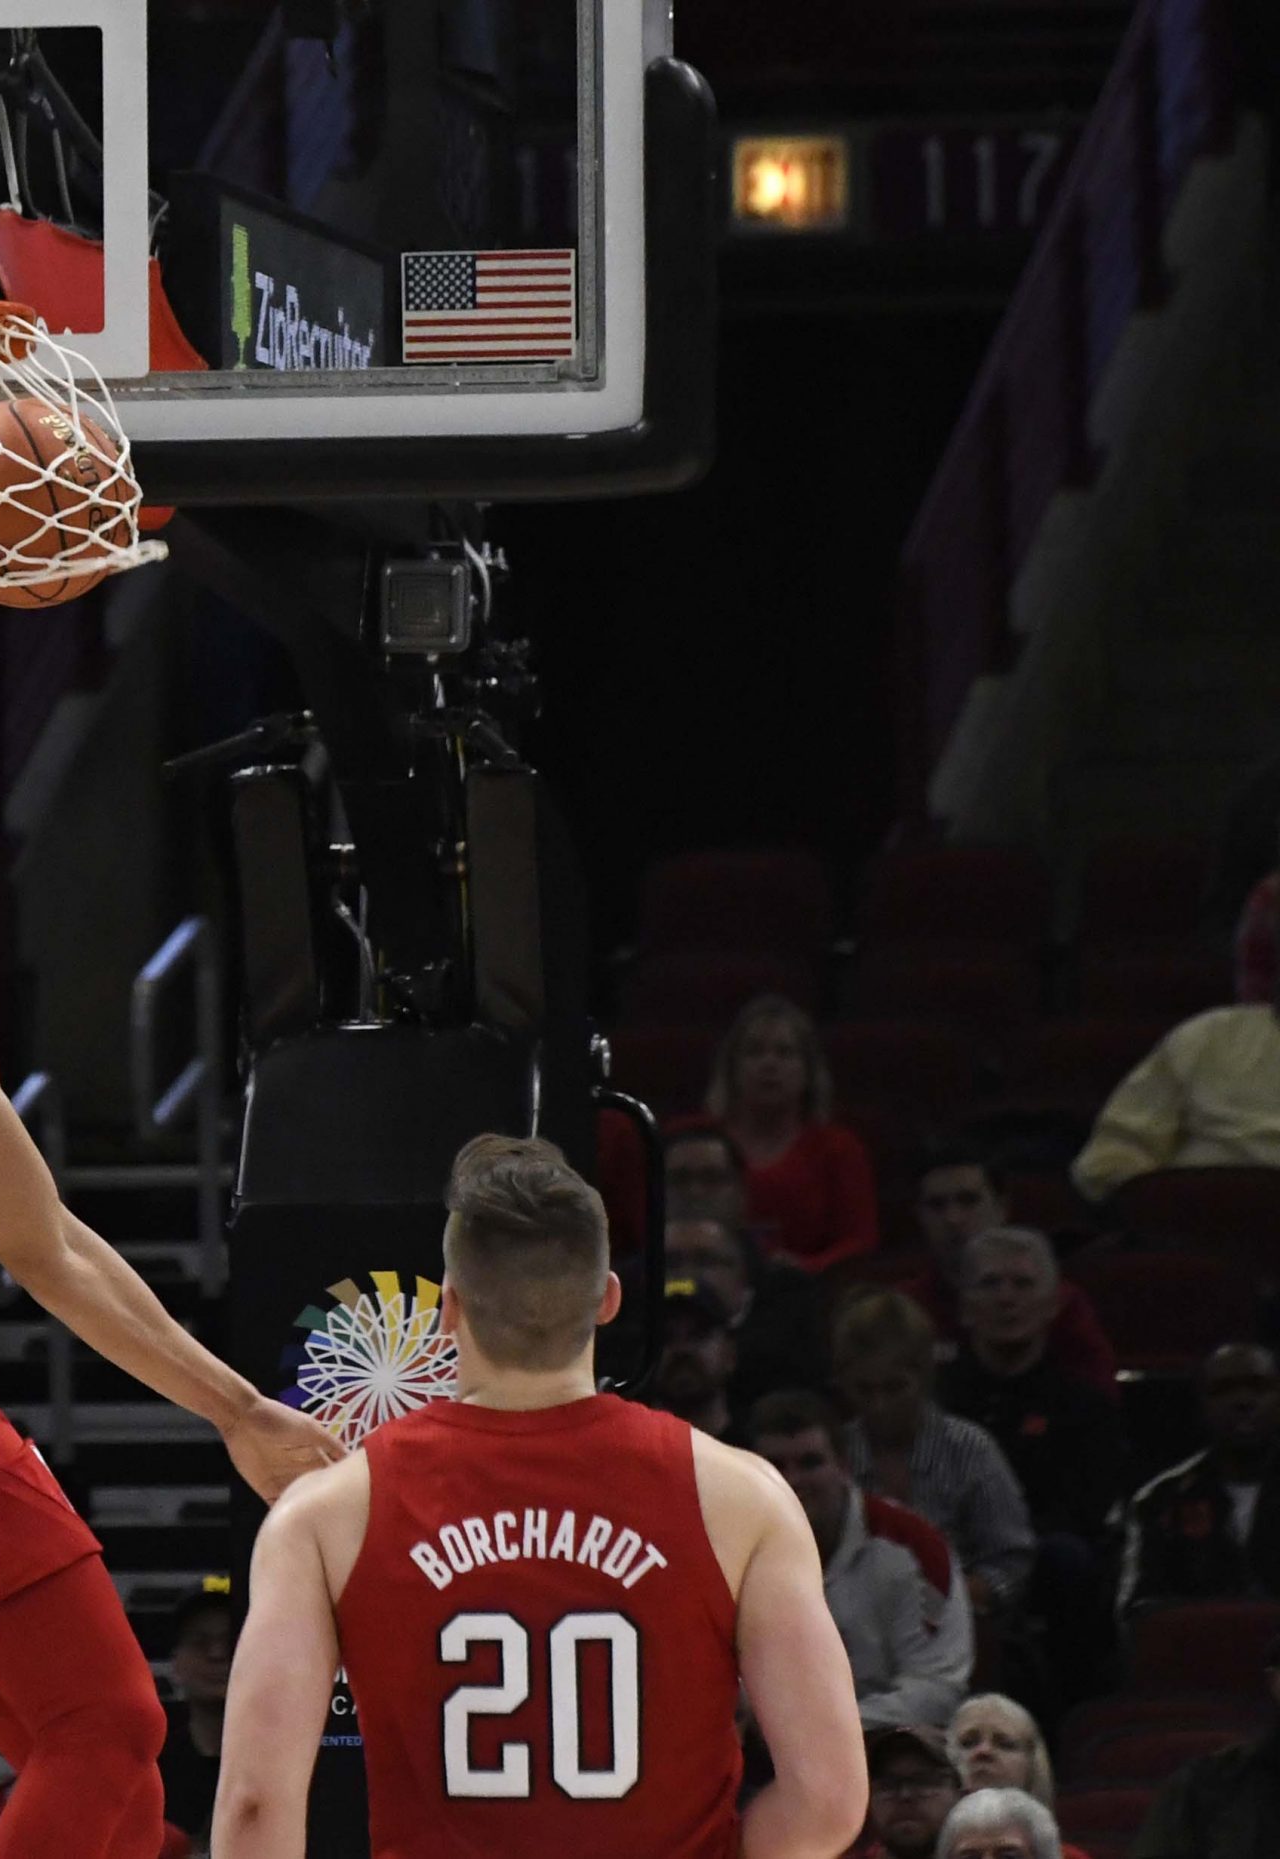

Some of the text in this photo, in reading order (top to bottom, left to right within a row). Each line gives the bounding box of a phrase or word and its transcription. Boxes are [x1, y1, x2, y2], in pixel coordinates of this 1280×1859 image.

[924, 132, 1062, 229] 117
[408, 1506, 670, 1592] BORCHARDT
[438, 1610, 643, 1801] 20
